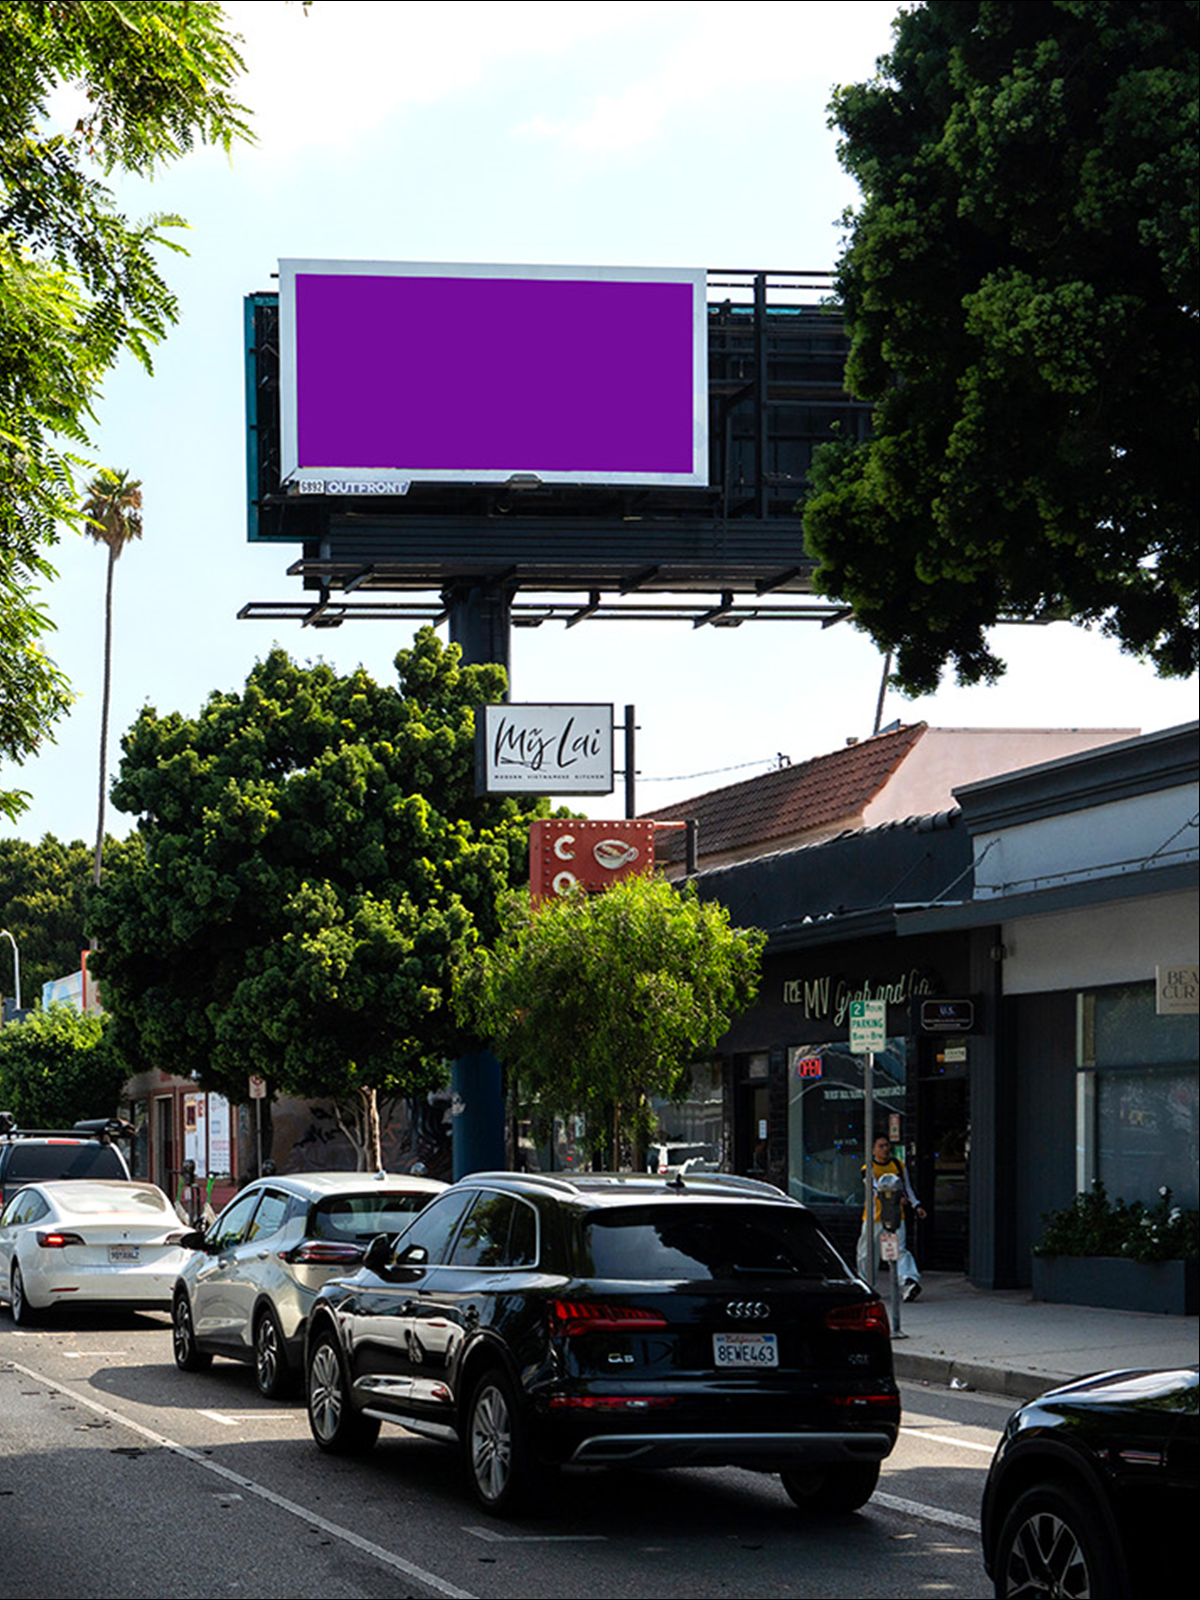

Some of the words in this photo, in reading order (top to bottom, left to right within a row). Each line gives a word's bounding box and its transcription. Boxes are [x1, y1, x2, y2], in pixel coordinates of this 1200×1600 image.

[328, 481, 406, 493] OUTFRONT
[556, 716, 601, 768] Lai
[804, 976, 831, 1019] MV
[853, 1003, 862, 1016] 2
[851, 1018, 883, 1029] PARKING
[798, 1058, 821, 1077] OPEN
[718, 1345, 775, 1362] 8EWE463
